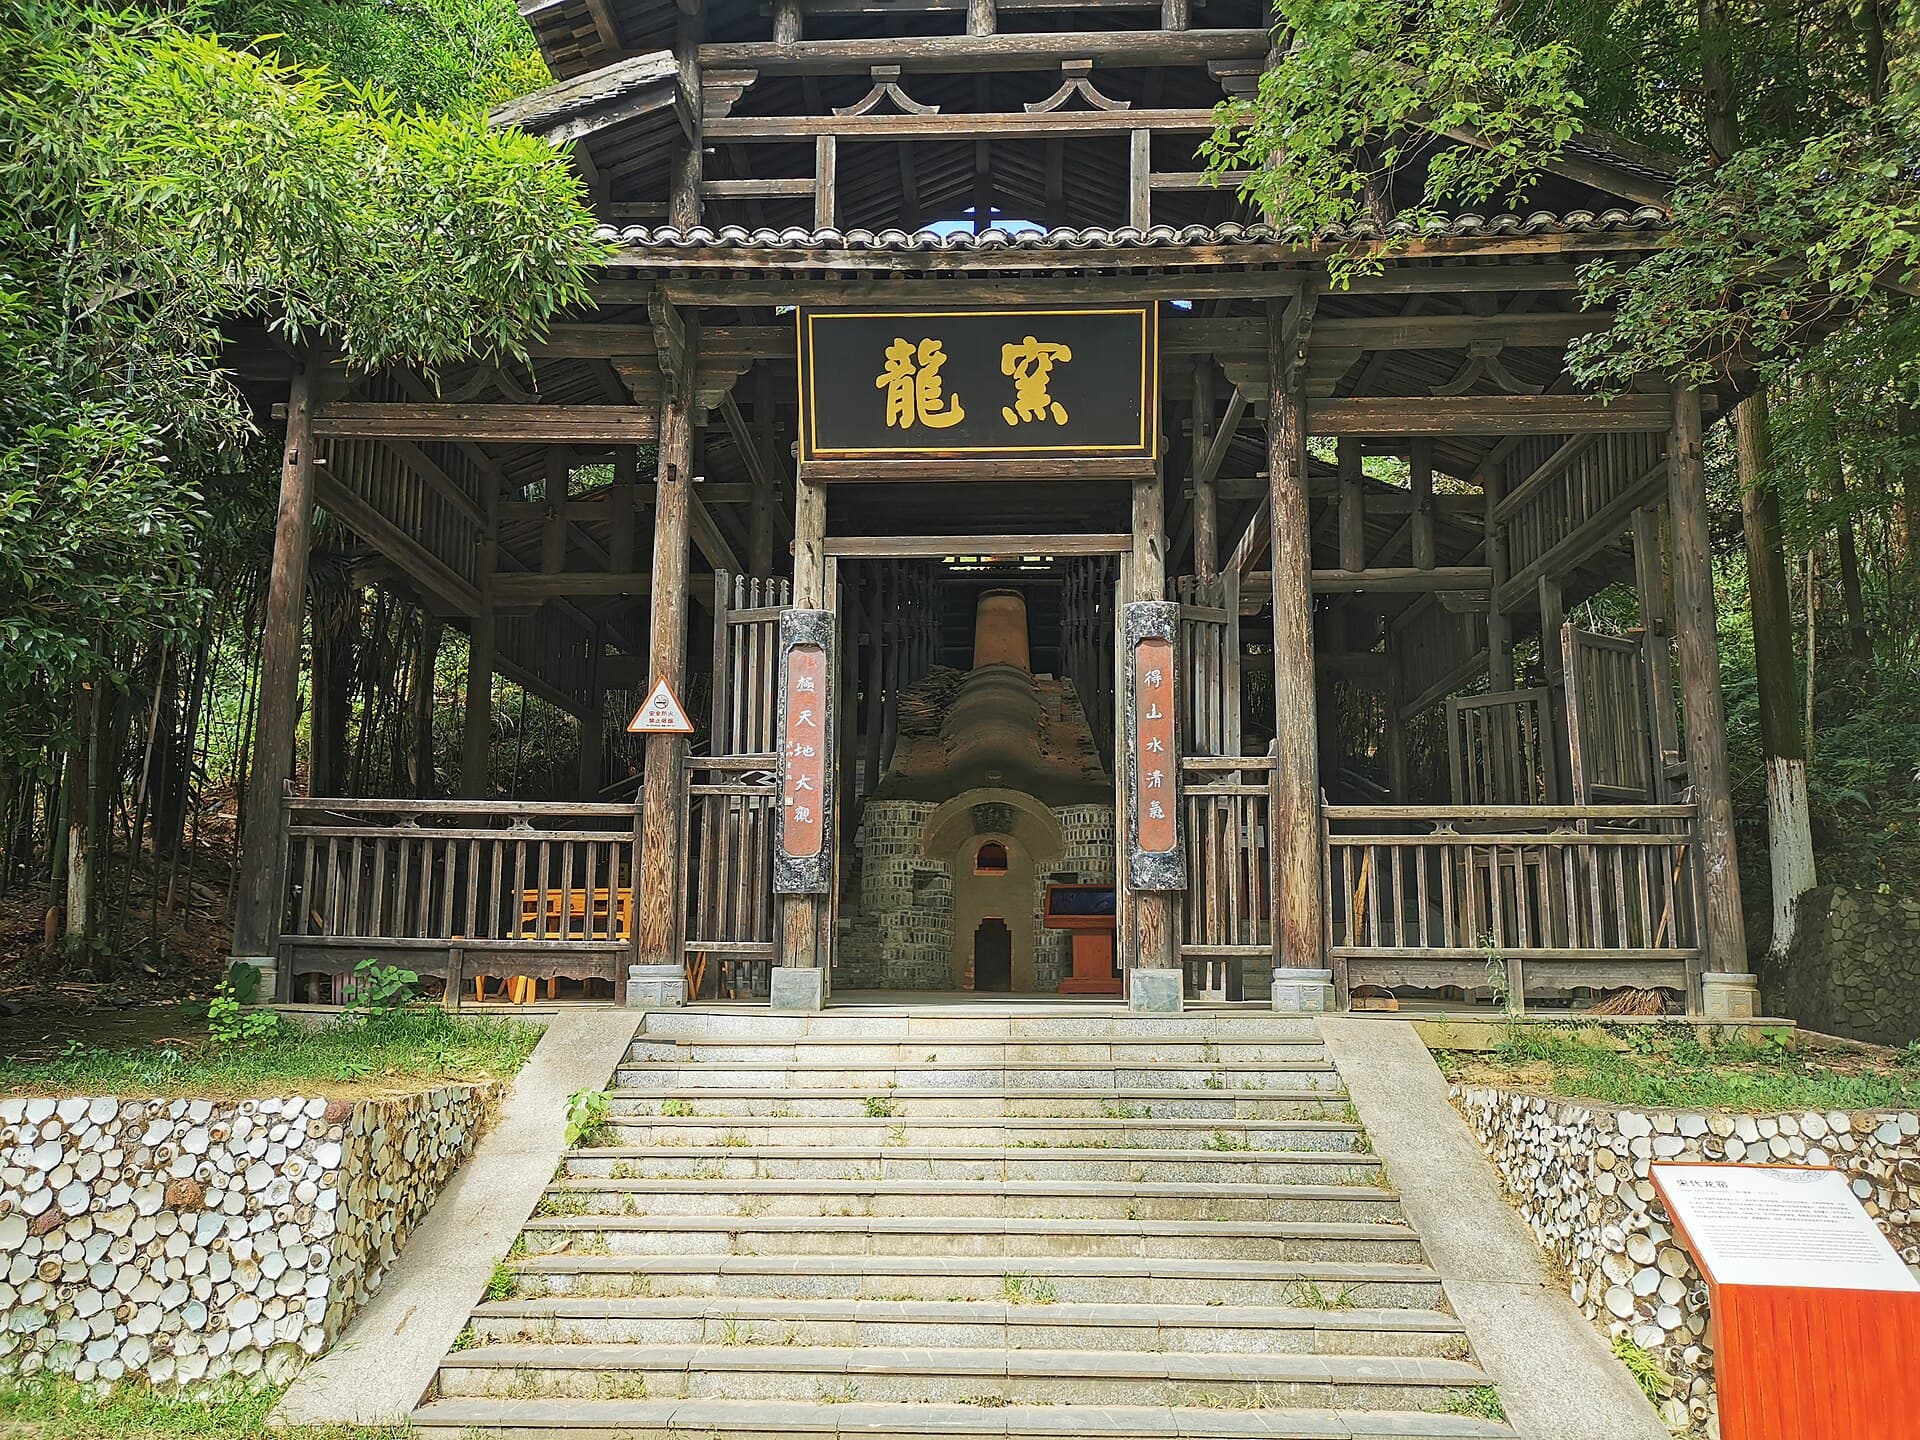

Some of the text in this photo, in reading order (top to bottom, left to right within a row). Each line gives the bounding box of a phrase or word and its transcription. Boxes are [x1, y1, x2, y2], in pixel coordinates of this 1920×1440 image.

[875, 335, 1074, 429] 龍窯
[1143, 669, 1166, 820] 得山水清氣
